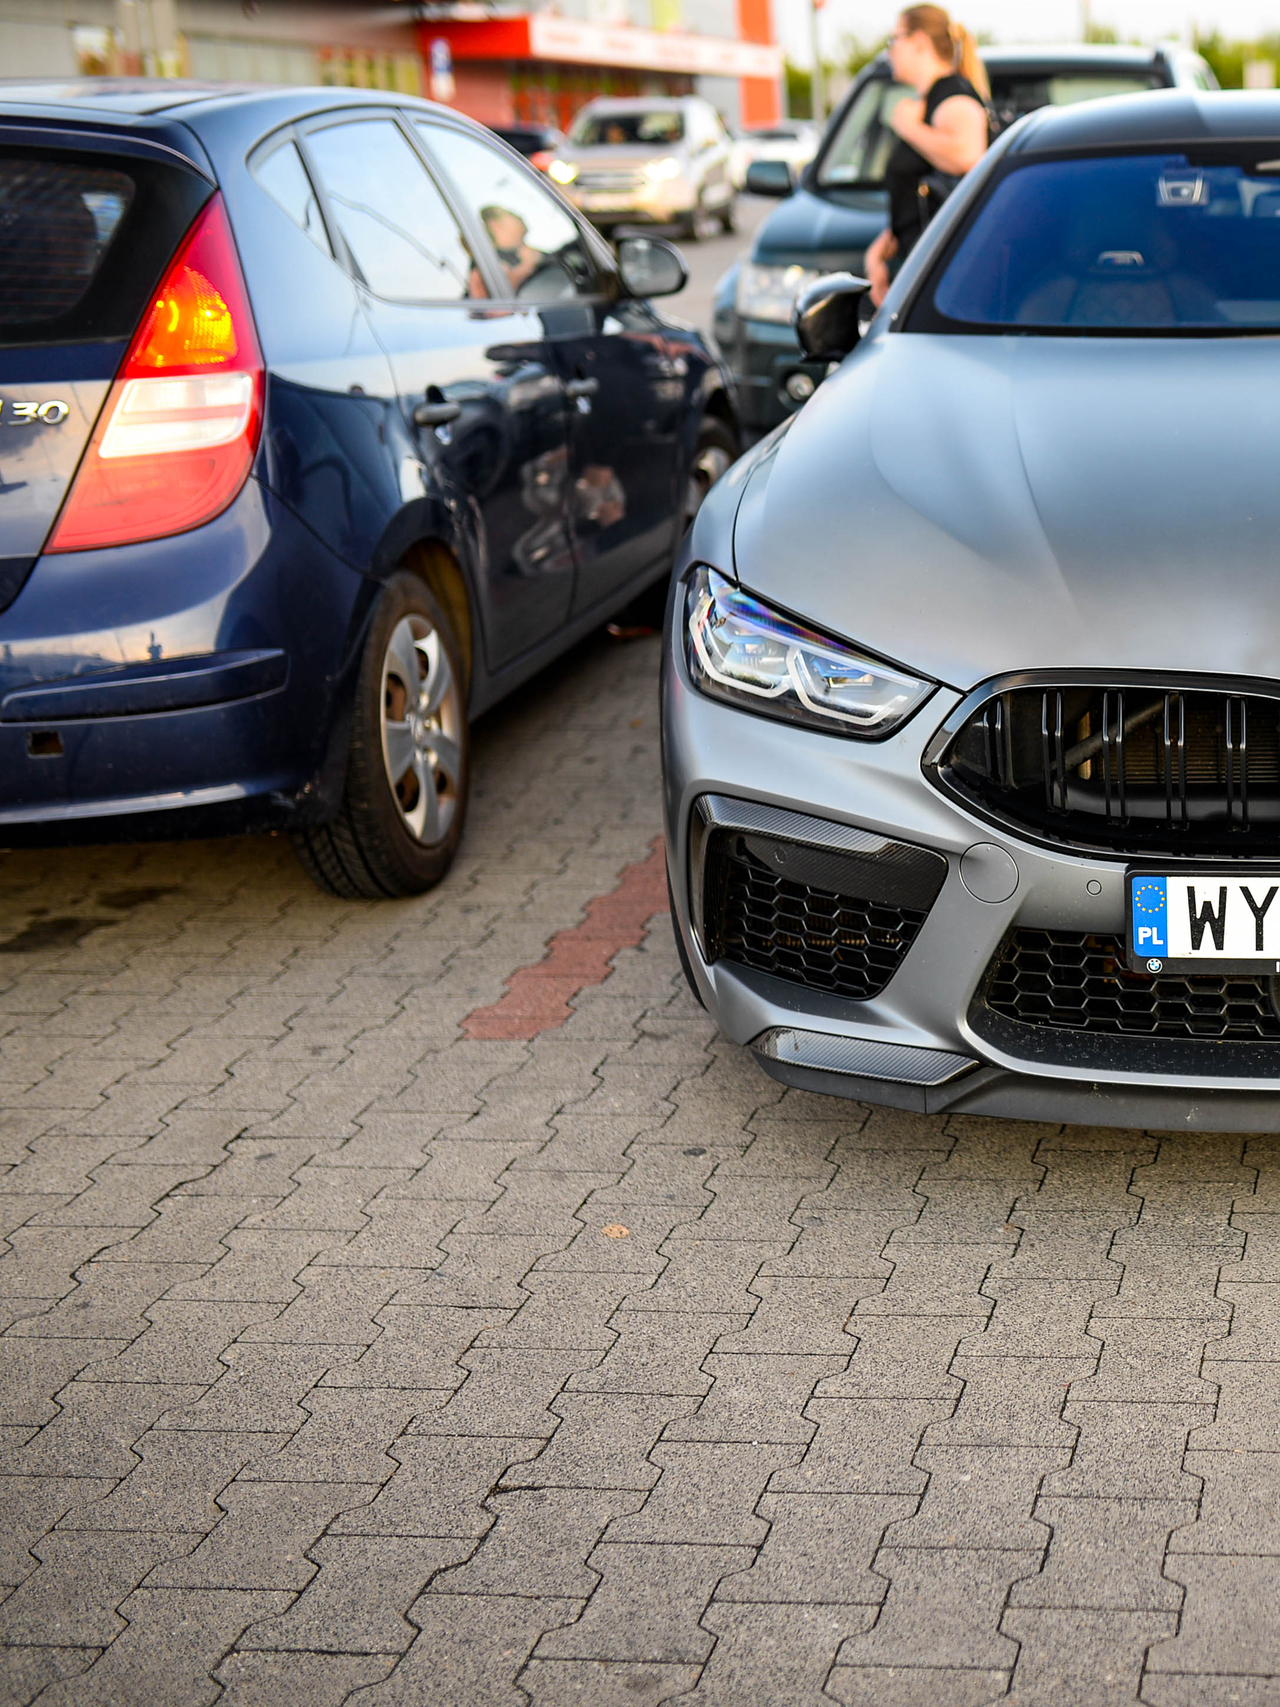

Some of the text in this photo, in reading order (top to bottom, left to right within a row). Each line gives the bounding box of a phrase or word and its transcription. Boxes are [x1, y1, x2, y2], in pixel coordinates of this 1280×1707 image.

[0, 399, 70, 426] 30
[1186, 884, 1280, 952] WY
[1138, 926, 1164, 945] PL
